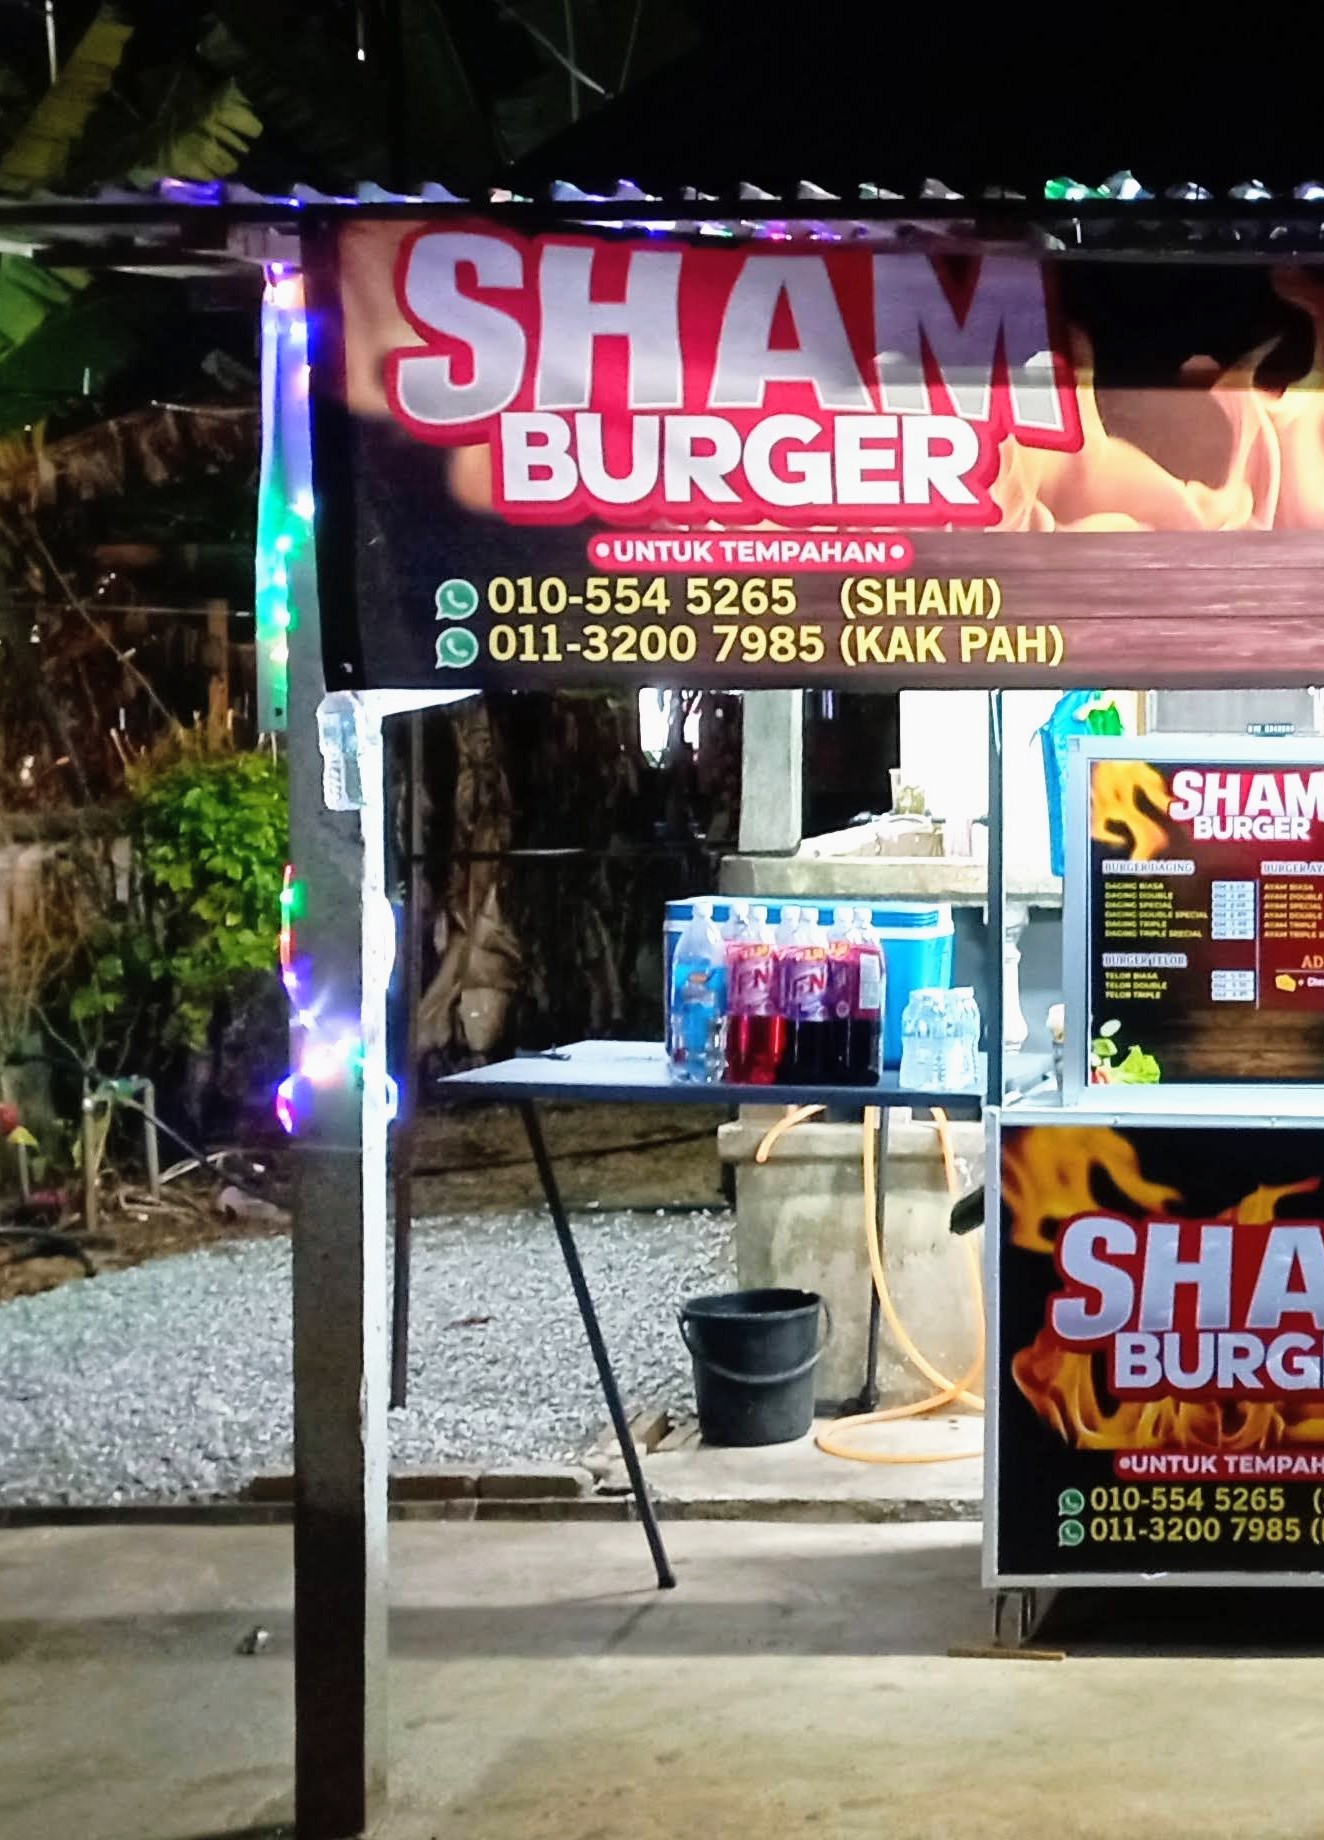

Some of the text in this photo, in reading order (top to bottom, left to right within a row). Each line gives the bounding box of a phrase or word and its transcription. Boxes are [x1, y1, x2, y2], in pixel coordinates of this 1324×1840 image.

[398, 231, 1066, 432] SHAM
[500, 411, 980, 506] BURGER
[614, 540, 886, 563] UNTUK TEMPAHAN
[487, 576, 1002, 619] 010-554 5265 (SHAM)
[488, 624, 1064, 667] 011-3200 7985 (KAK PAH)
[1193, 815, 1311, 841] BURGER
[1131, 1456, 1217, 1473] UNTUK
[1090, 1487, 1204, 1511] 010-554
[1214, 1488, 1285, 1511] 5265
[1090, 1518, 1221, 1542] 011-3200
[1231, 1518, 1301, 1543] 7985
